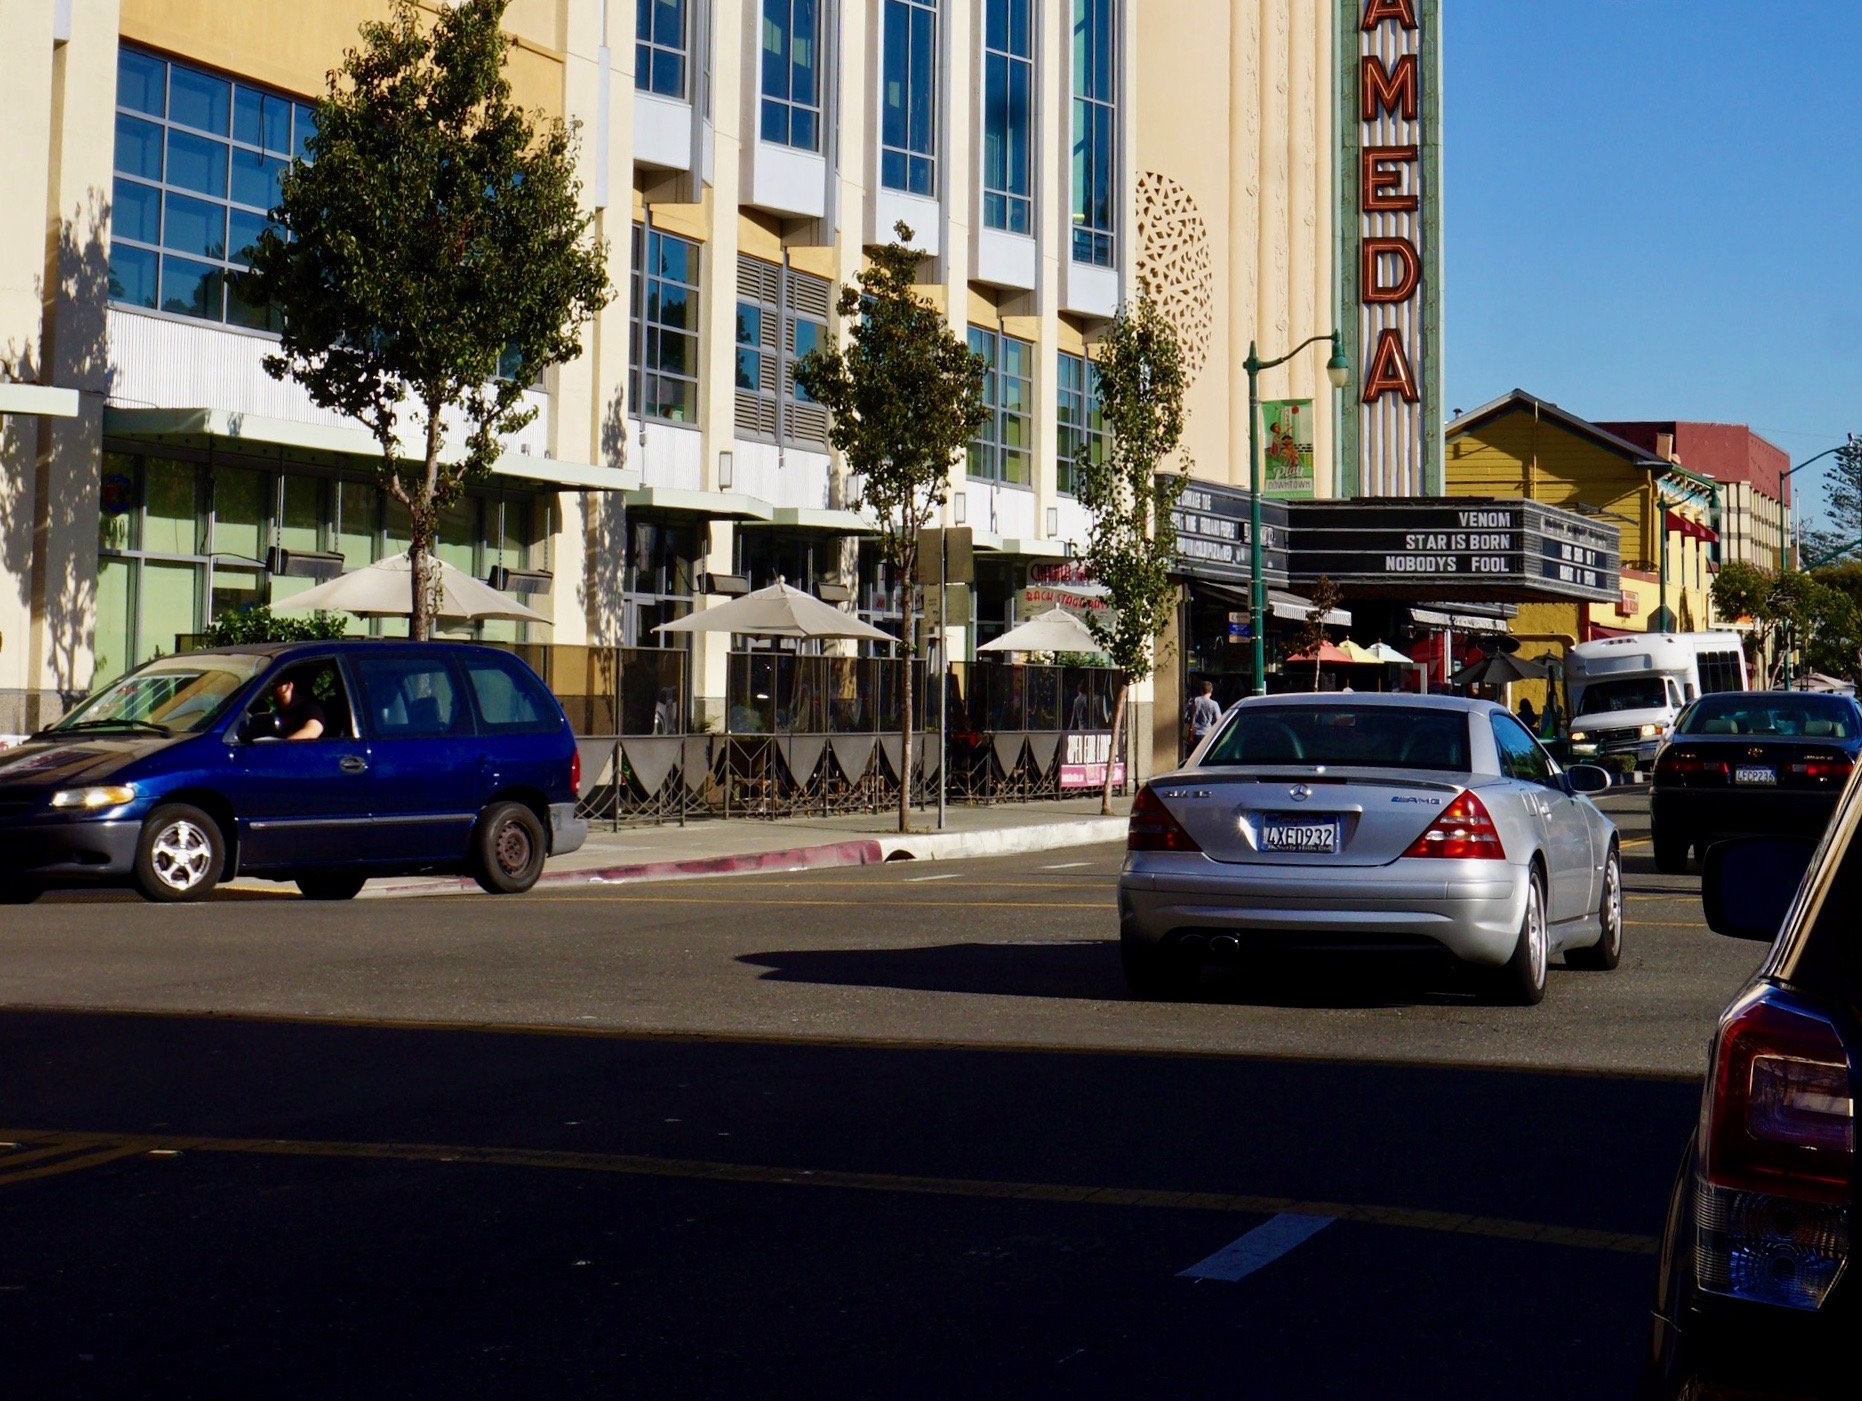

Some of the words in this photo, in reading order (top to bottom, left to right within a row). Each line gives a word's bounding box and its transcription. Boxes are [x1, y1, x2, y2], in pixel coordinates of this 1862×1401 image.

[1273, 465, 1305, 481] Play
[1268, 480, 1311, 490] DOWNTOWN
[1459, 511, 1510, 527] VENOM
[1406, 534, 1447, 550] STAR
[1451, 534, 1466, 550] IS
[1470, 534, 1510, 550] BORN
[1385, 555, 1456, 572] NOBODYS
[1471, 557, 1510, 572] FOOL
[1025, 590, 1055, 603] BACK
[1067, 735, 1083, 764] OPEN
[1084, 735, 1096, 764] FOR
[1267, 827, 1333, 846] 4XED932
